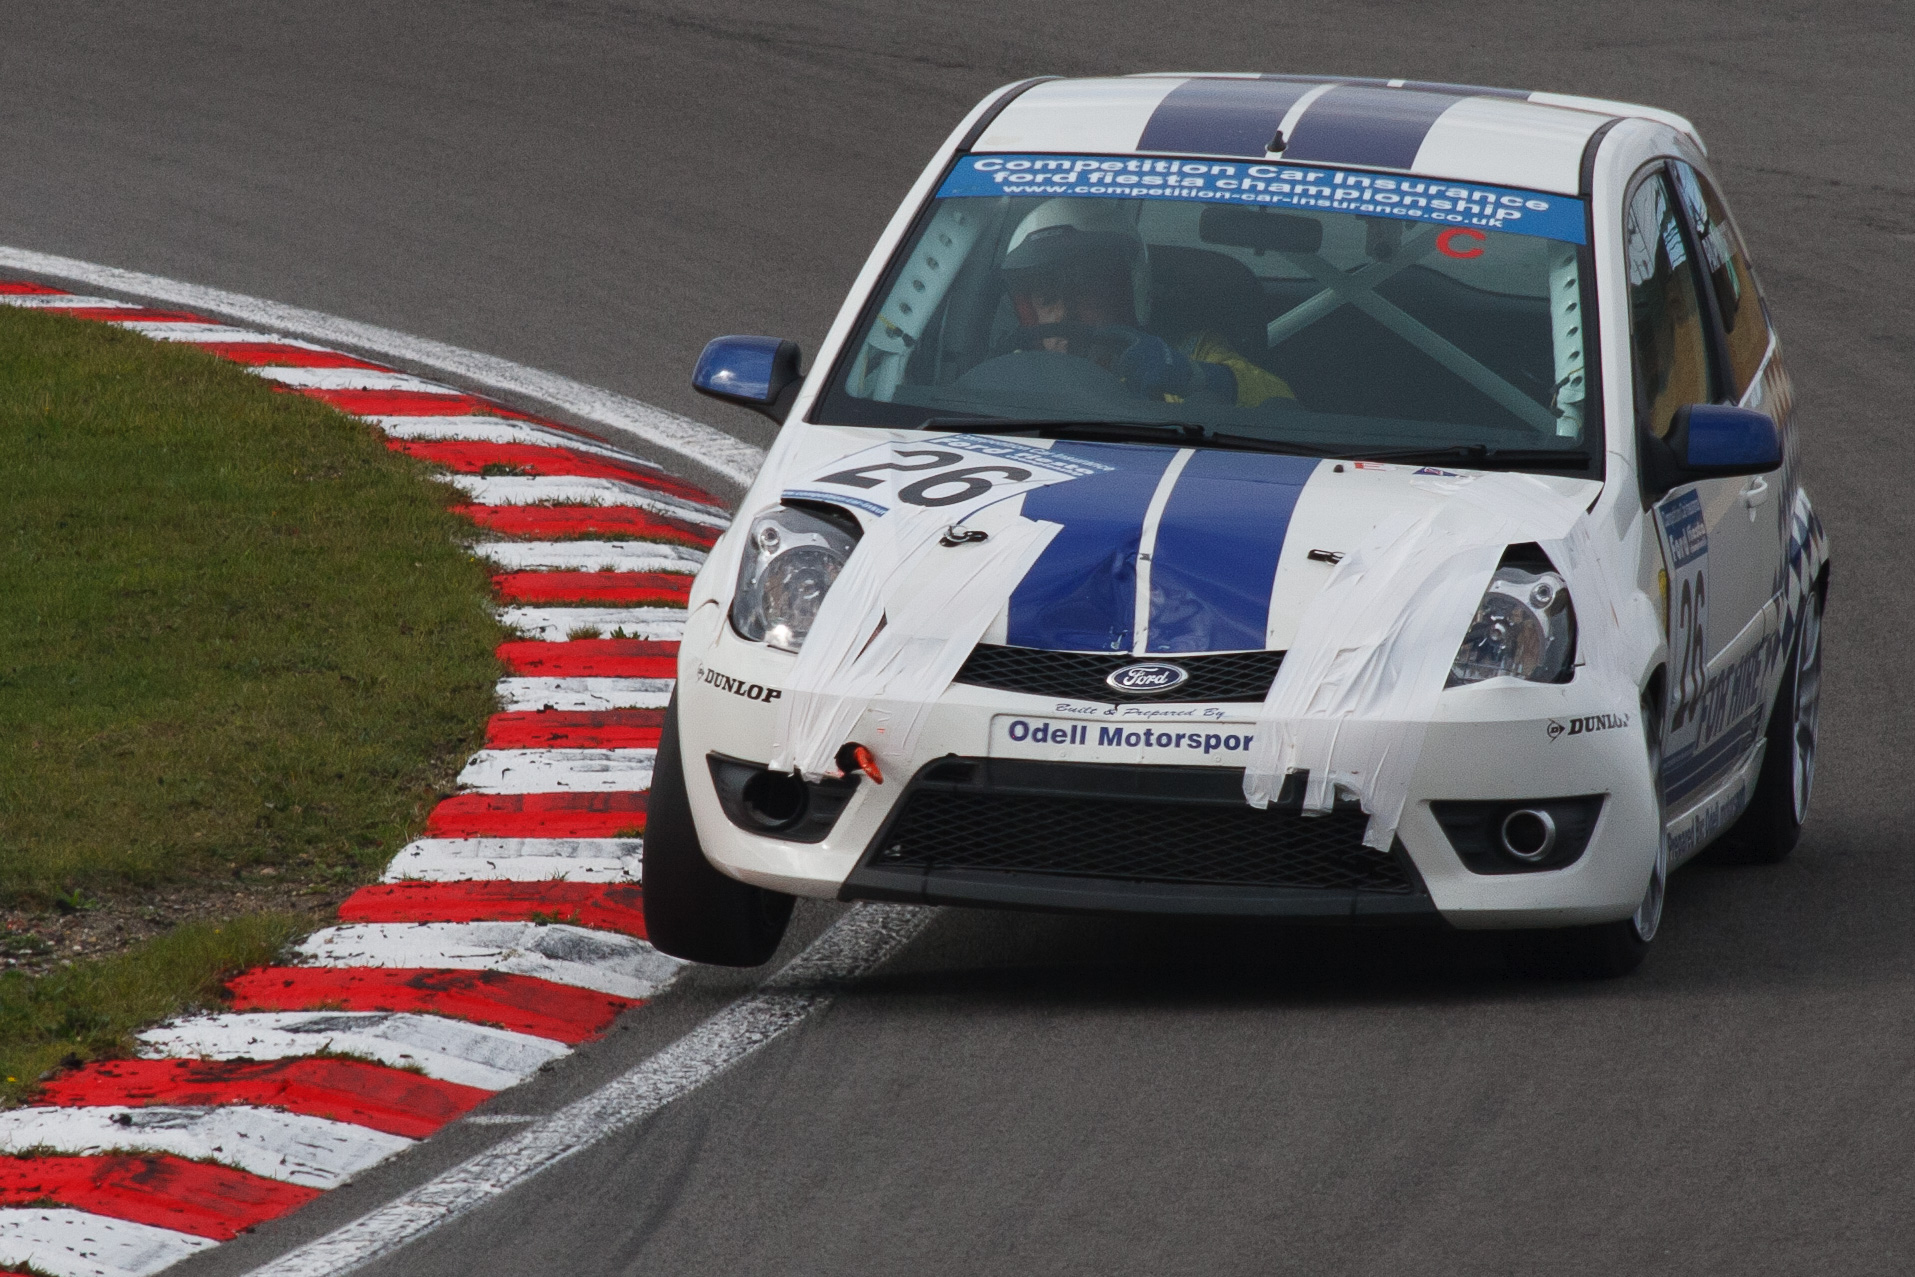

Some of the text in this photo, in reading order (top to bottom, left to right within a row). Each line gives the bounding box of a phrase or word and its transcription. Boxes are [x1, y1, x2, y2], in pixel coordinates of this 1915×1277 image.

[973, 158, 1550, 211] Competition Car Insurance
[993, 171, 1522, 220] ford fiesta championship
[1003, 185, 1504, 228] www.competition-car-insurance.co.uk
[1436, 226, 1487, 260] C
[812, 449, 1033, 508] 26
[1671, 569, 1706, 734] 26
[704, 668, 782, 704] DUNLOP
[1123, 667, 1170, 686] Ford
[1055, 703, 1226, 720] Built & Prepared By
[1008, 720, 1088, 745] Odell
